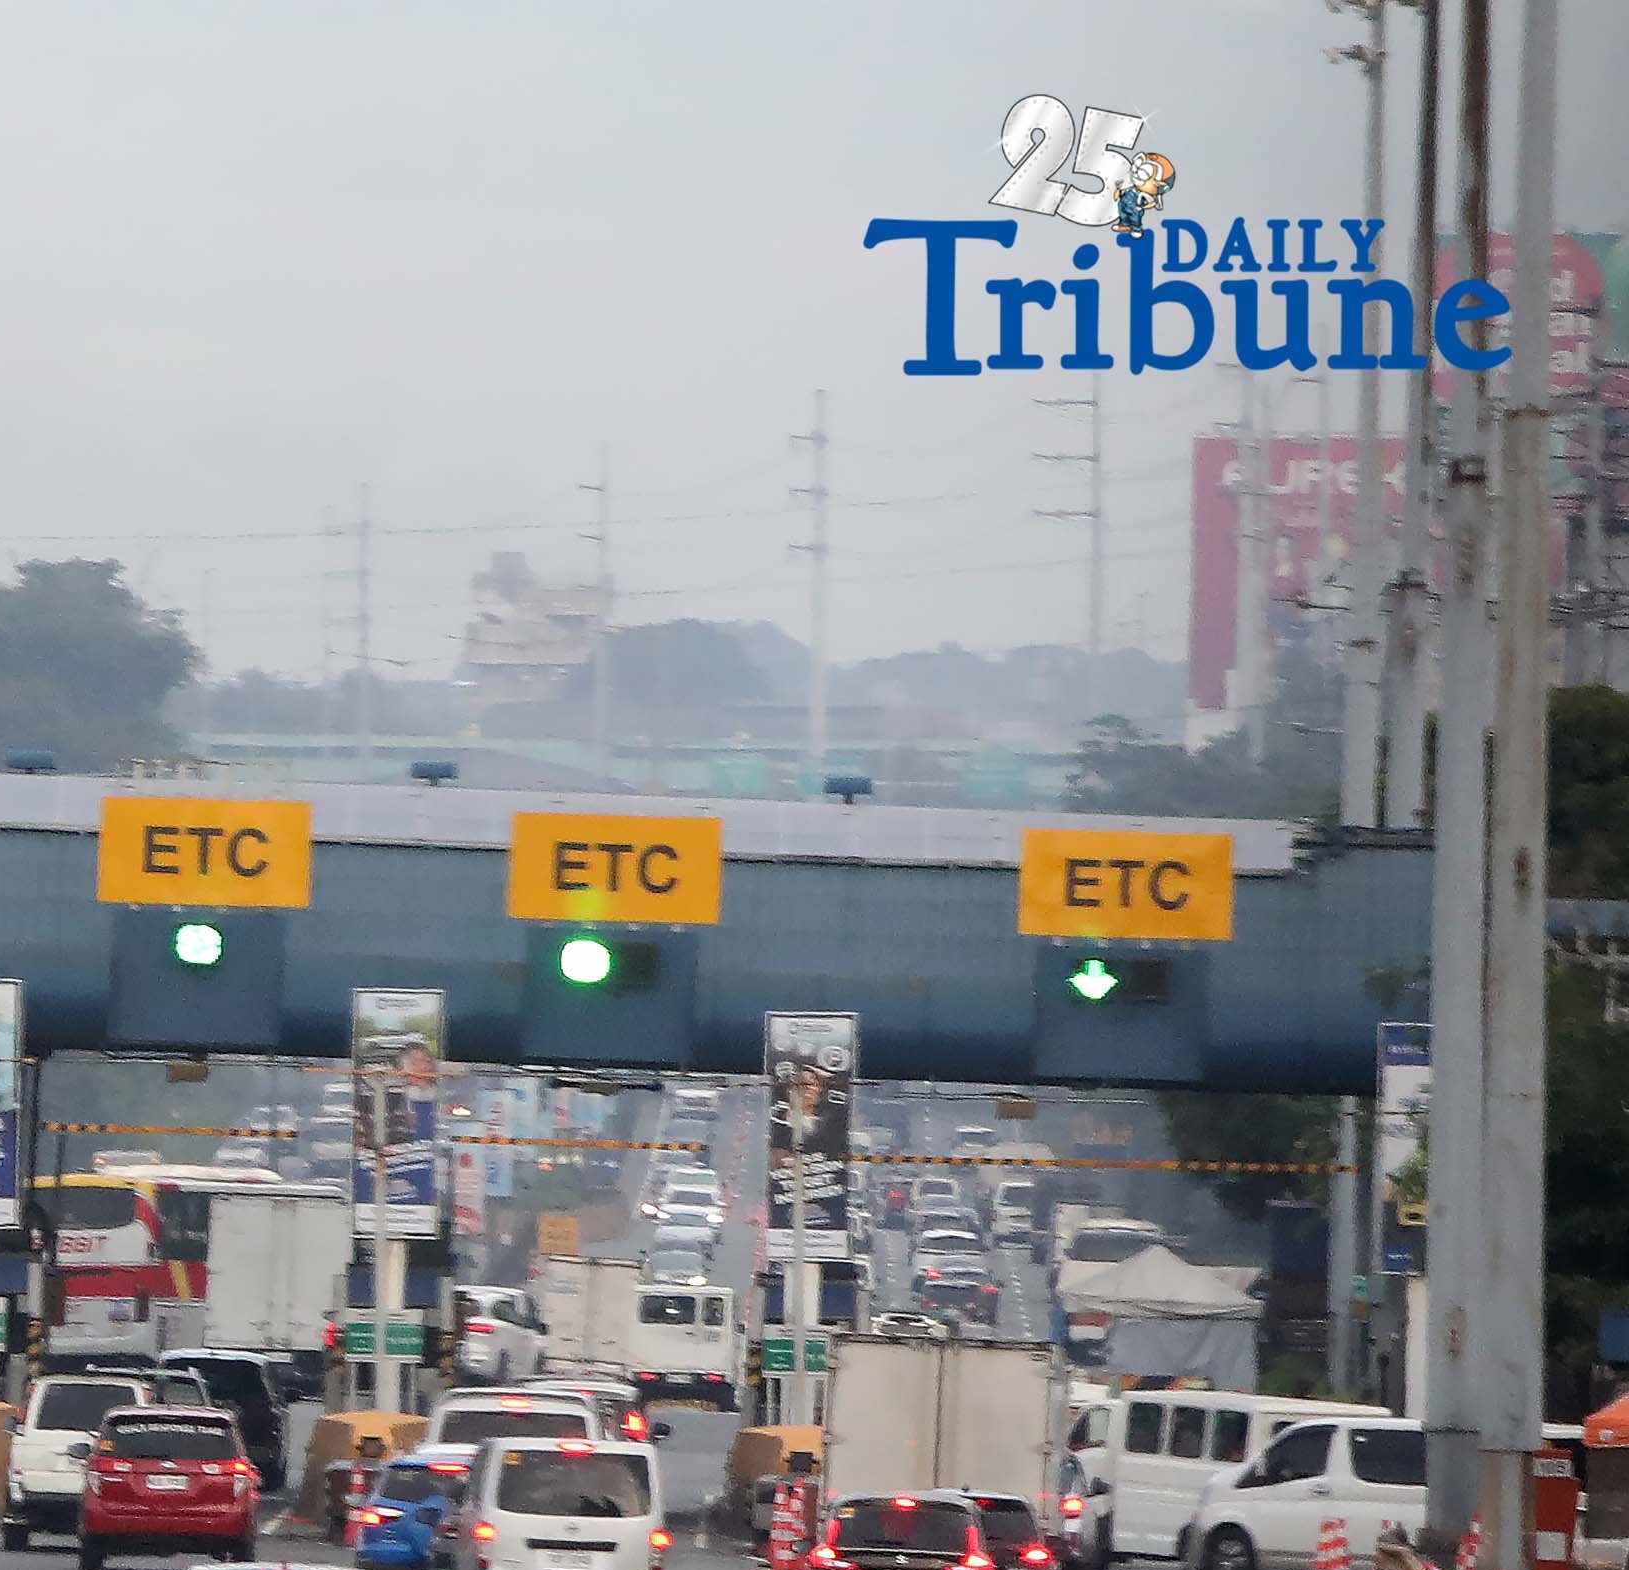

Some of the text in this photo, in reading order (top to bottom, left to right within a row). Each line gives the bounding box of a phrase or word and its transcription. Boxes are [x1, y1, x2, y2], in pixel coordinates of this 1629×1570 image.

[143, 826, 269, 877] ETC
[554, 842, 679, 893] ETC
[1064, 859, 1191, 910] ETC
